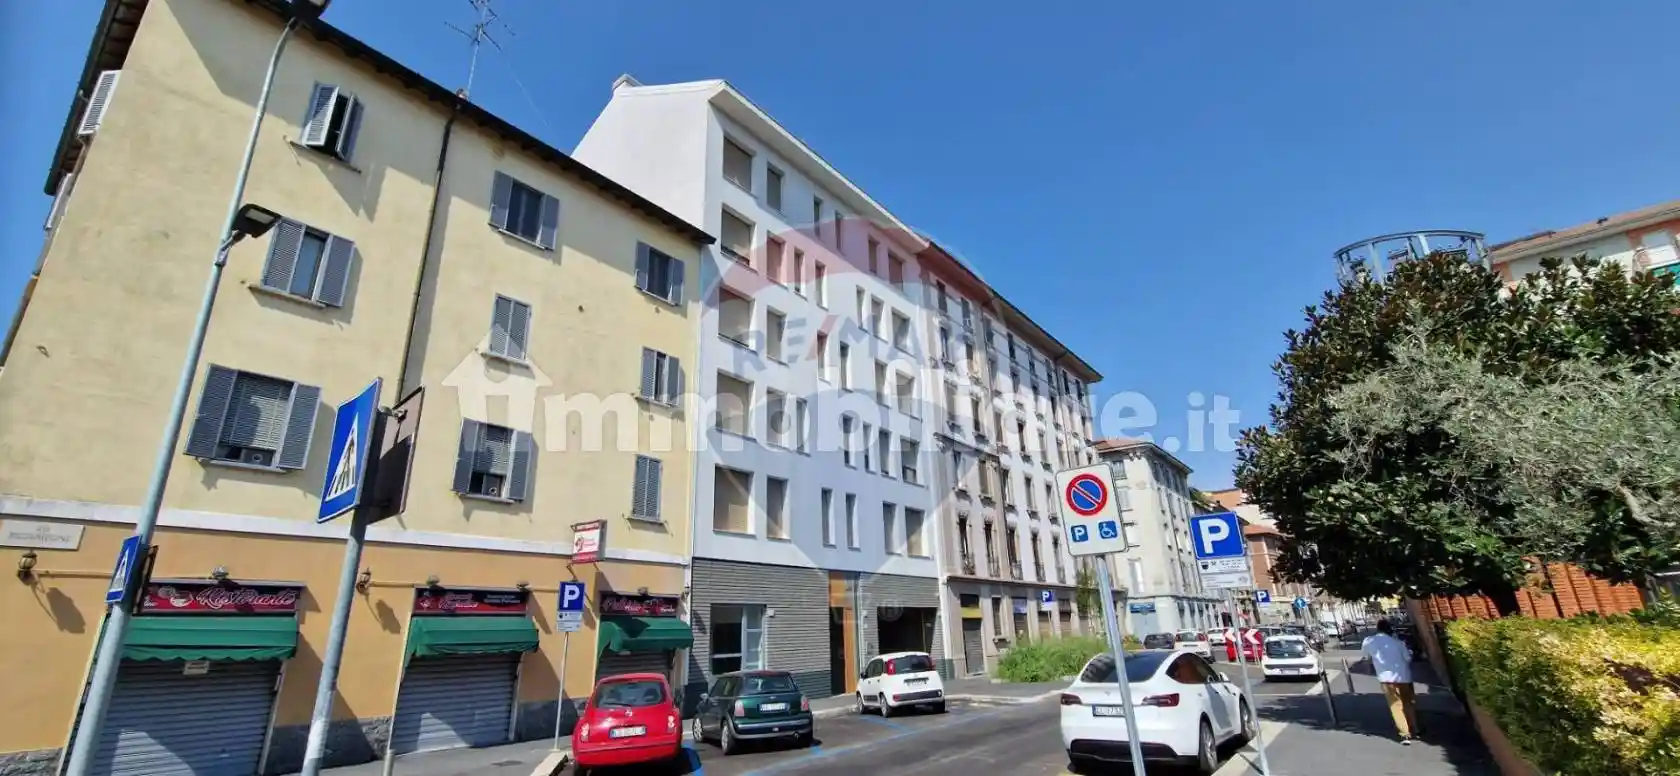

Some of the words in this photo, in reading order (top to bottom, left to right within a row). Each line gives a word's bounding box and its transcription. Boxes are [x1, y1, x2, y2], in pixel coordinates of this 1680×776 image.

[1074, 528, 1085, 540] P
[1198, 518, 1230, 554] P
[563, 584, 581, 608] P
[1042, 591, 1050, 601] P
[1257, 591, 1266, 602] P
